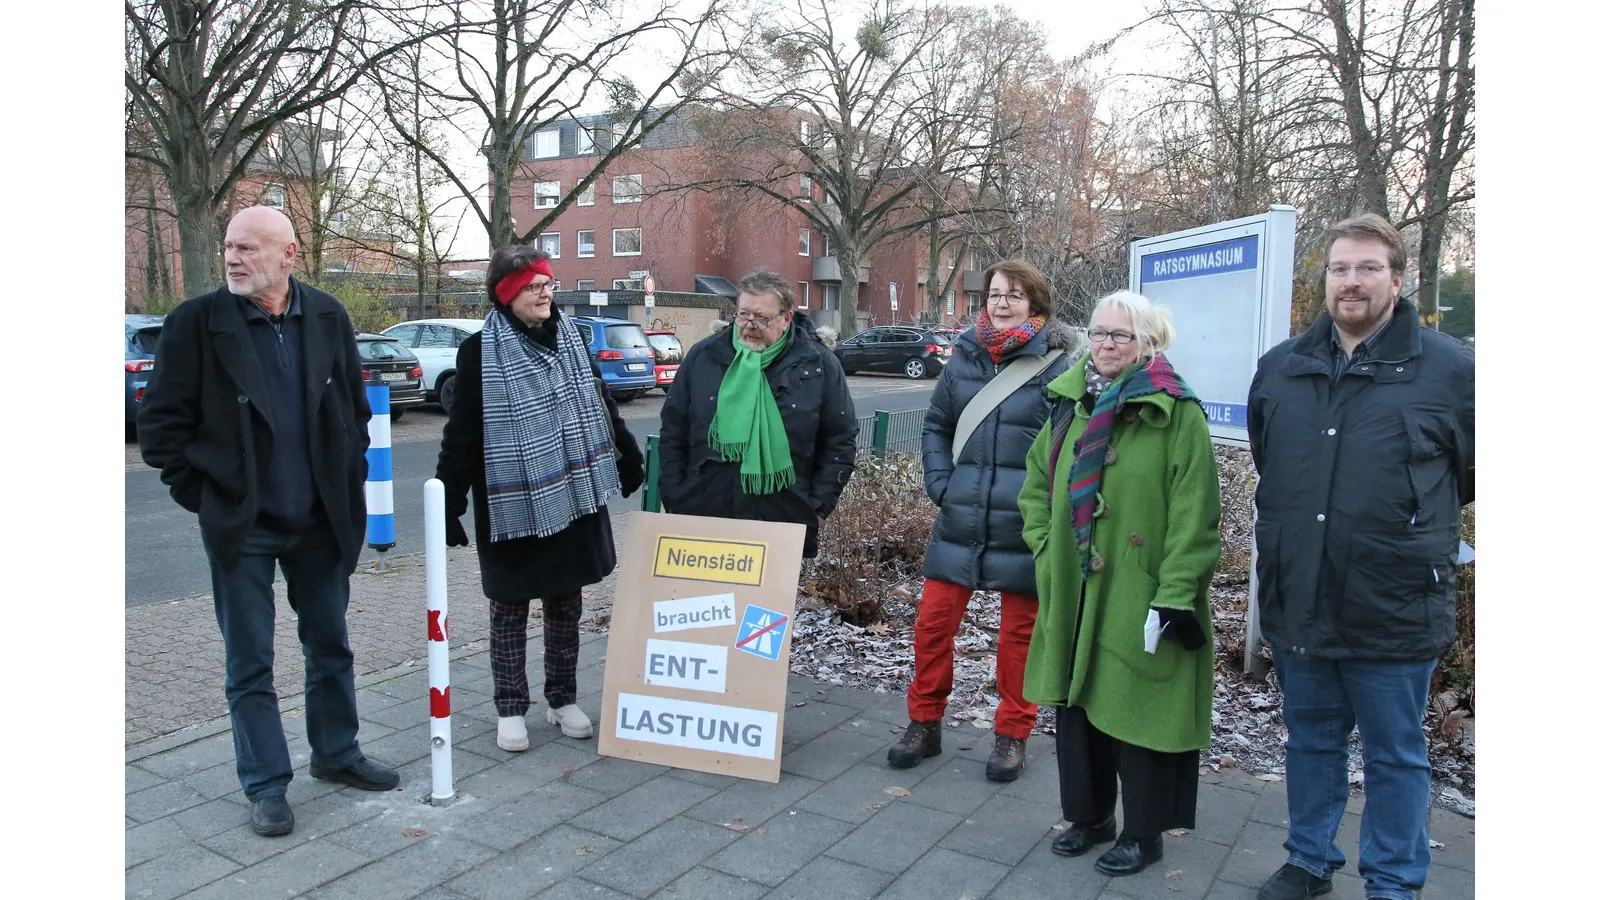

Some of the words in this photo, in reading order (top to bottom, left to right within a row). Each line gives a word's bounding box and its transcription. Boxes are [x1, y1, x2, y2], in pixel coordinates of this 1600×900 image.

[1153, 246, 1243, 276] RATSGYMNASIUM
[667, 548, 754, 573] Nienstädt
[657, 605, 731, 627] braucht
[649, 654, 718, 680] ENT-
[620, 707, 762, 748] LASTUNG
